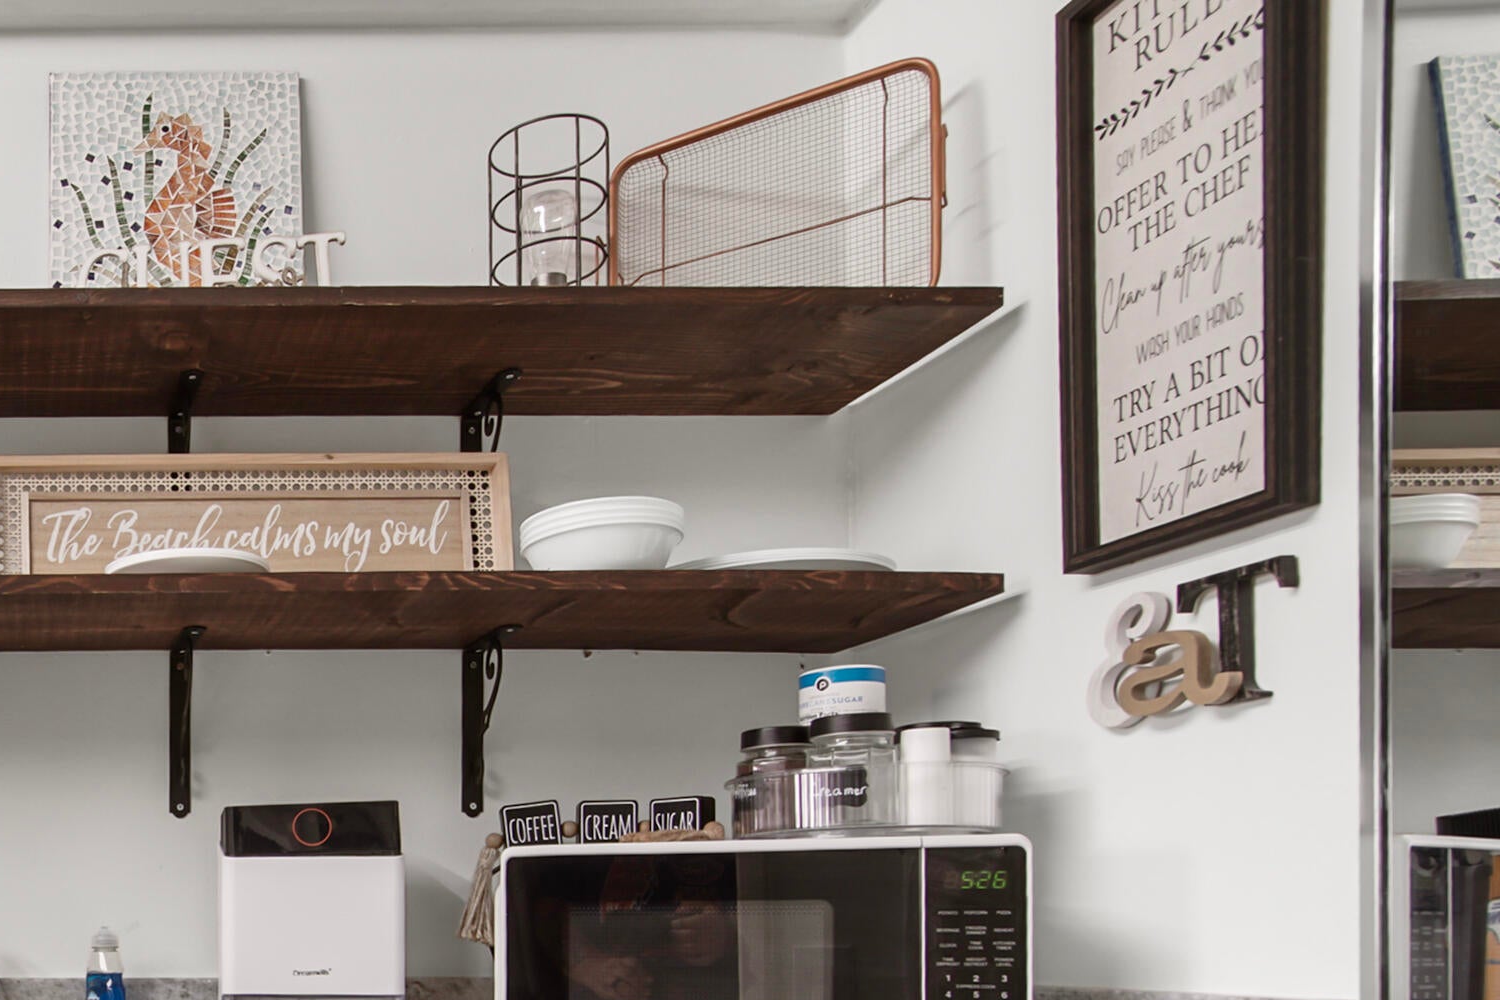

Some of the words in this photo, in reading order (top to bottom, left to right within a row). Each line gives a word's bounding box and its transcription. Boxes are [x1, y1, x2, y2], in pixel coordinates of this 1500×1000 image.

[1182, 99, 1193, 133] &
[1097, 170, 1168, 234] OFFER
[1177, 143, 1212, 185] TO
[1222, 103, 1264, 160] HE
[1128, 201, 1176, 252] THE
[1185, 154, 1251, 218] CHEF
[1102, 272, 1147, 335] Clean
[1136, 330, 1169, 365] WASH
[1175, 314, 1202, 347] YOUR
[1206, 292, 1244, 332] HANDS
[1113, 380, 1156, 423] TRY
[1164, 372, 1181, 403] A
[1189, 346, 1230, 392] BIT
[1240, 330, 1264, 367] O
[1135, 461, 1179, 527] Kiss
[1178, 449, 1207, 515] the
[1212, 430, 1250, 482] cook
[42, 507, 103, 564] The
[108, 504, 222, 559] Beach
[223, 503, 318, 558] calms
[323, 521, 372, 573] my
[380, 500, 449, 555] soul
[831, 695, 863, 705] SUGAR
[508, 813, 557, 844] COFFEE
[584, 813, 632, 841] CREAM
[655, 811, 694, 832] SUGAR
[961, 871, 1008, 889] 5:26
[945, 974, 952, 982] 1
[972, 974, 980, 983] 2
[1001, 974, 1008, 983] 3
[945, 990, 952, 998] 4
[972, 990, 980, 999] 5
[1001, 991, 1008, 1000] 6
